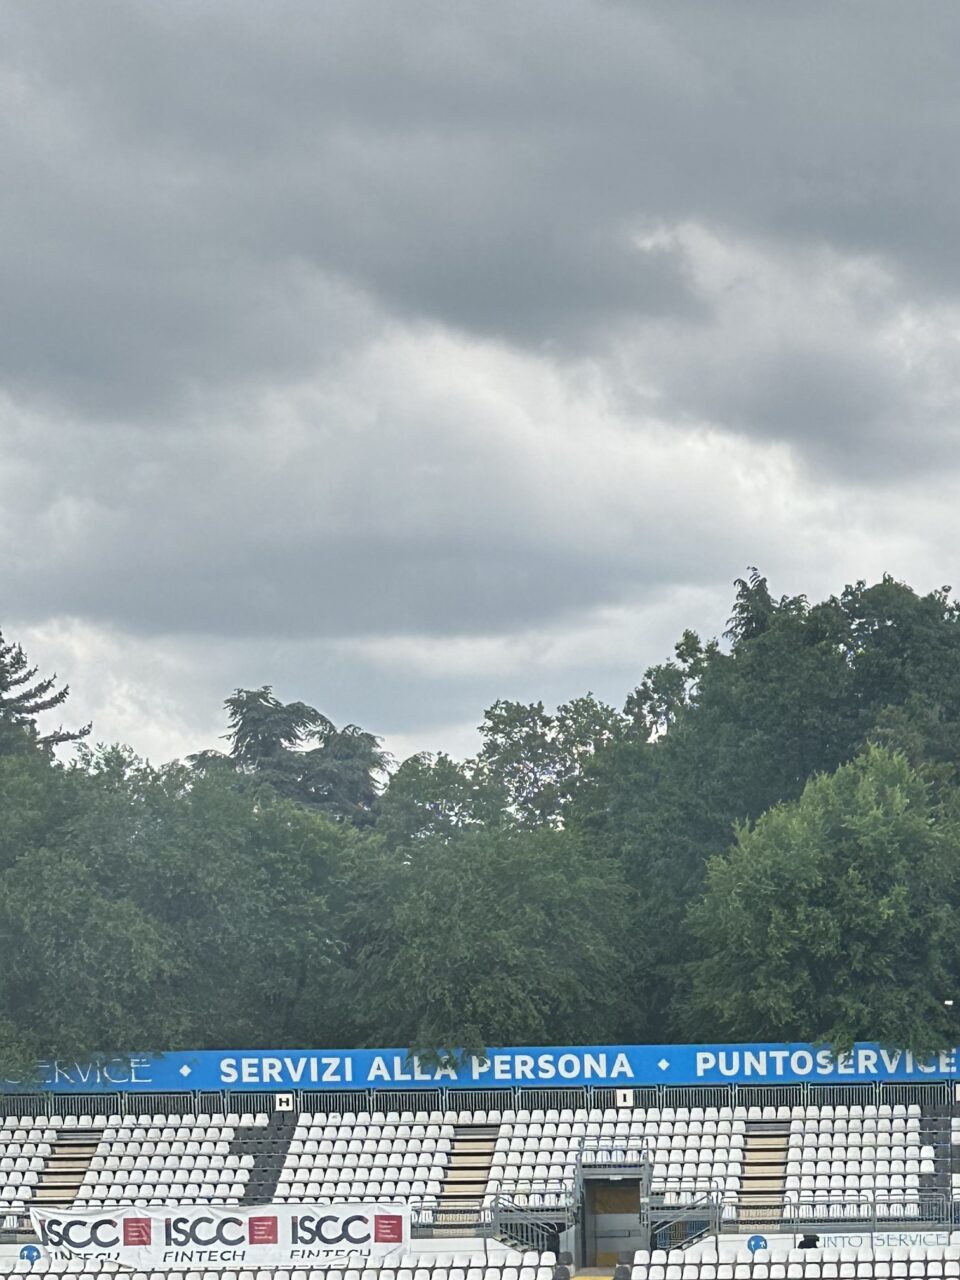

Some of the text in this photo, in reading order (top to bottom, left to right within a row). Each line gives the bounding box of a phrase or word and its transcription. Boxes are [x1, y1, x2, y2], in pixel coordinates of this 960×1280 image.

[220, 1055, 352, 1083] SERVIZI
[471, 1052, 635, 1081] PERSONA
[278, 1097, 290, 1107] H
[622, 1093, 628, 1103] I
[39, 1218, 120, 1249] ISCC
[165, 1216, 246, 1247] ISCC
[291, 1214, 372, 1245] ISCC
[873, 1232, 948, 1248] SERVICE
[163, 1249, 246, 1263] FINTECH
